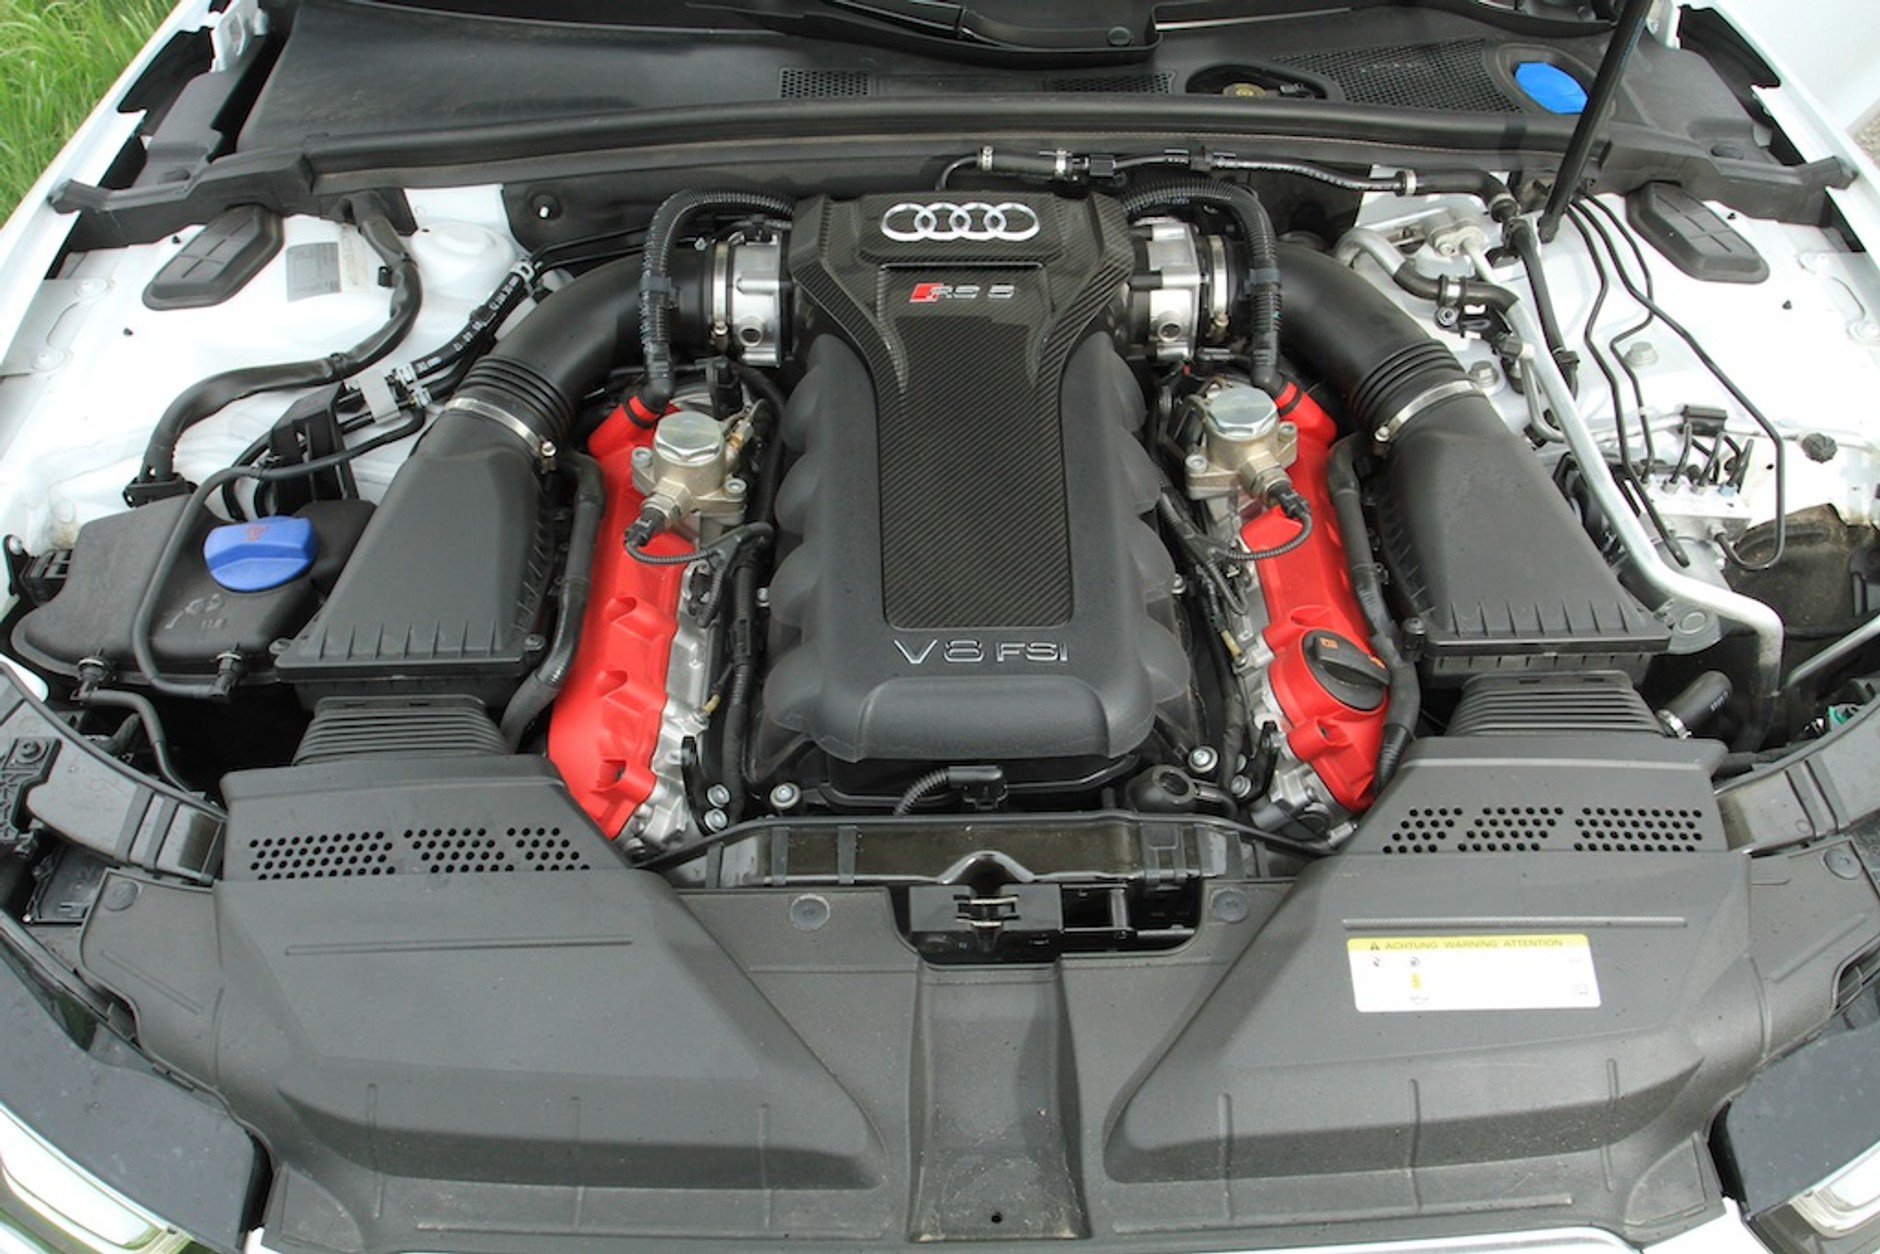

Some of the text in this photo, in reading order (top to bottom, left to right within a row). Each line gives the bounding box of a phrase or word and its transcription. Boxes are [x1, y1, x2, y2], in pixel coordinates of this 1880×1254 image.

[916, 284, 1015, 301] RS 5
[894, 639, 1068, 664] V8 FSI
[1385, 939, 1563, 950] ACHTUNG WARNING ATTENTION
